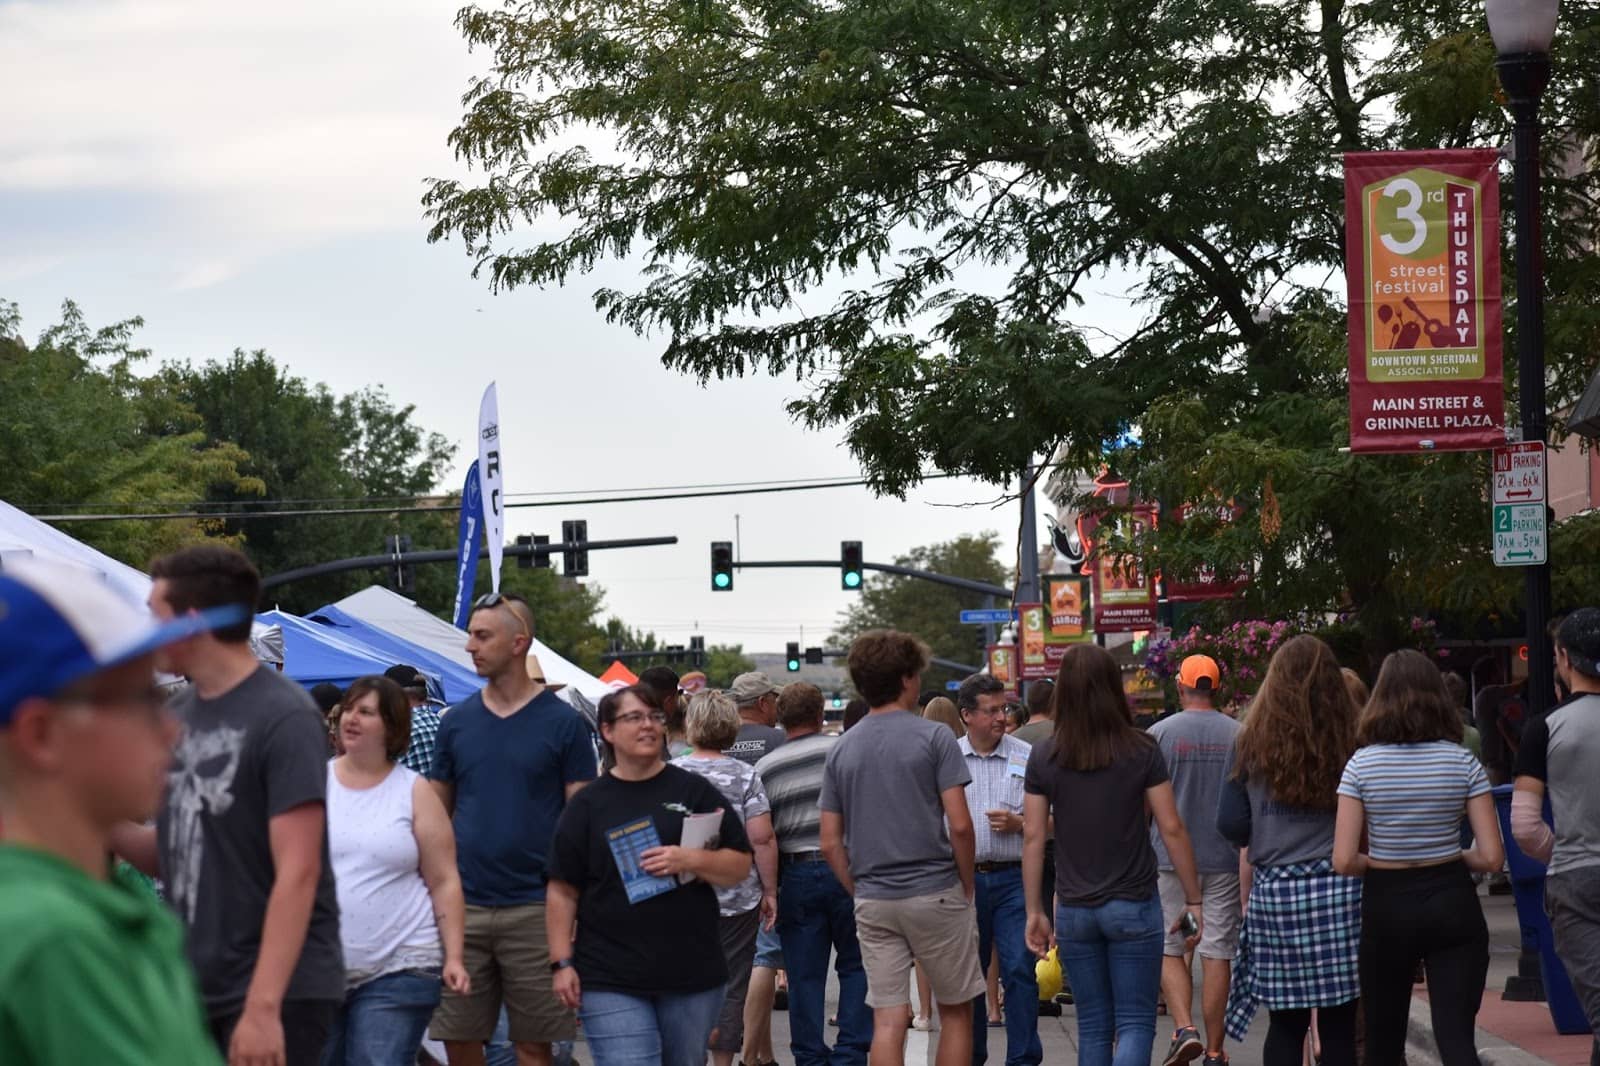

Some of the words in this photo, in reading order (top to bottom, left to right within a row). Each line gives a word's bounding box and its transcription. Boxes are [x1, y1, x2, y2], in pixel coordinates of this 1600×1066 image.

[1390, 264, 1446, 278] street
[1454, 192, 1469, 343] THURSDAY
[1375, 279, 1444, 295] festival
[1371, 354, 1426, 367] DOWNTOWN
[1431, 353, 1479, 365] SHERIDAN
[1387, 366, 1459, 376] ASSOCIATION
[1372, 398, 1415, 411] MAIN
[1419, 396, 1469, 410] STREET
[1473, 396, 1485, 408] &
[1365, 416, 1441, 431] GRINNELL
[1444, 414, 1493, 428] PLAZA
[1497, 453, 1508, 470] NO
[1513, 454, 1541, 468] PARKING
[1499, 509, 1508, 529] 2
[1513, 518, 1543, 532] PARKING
